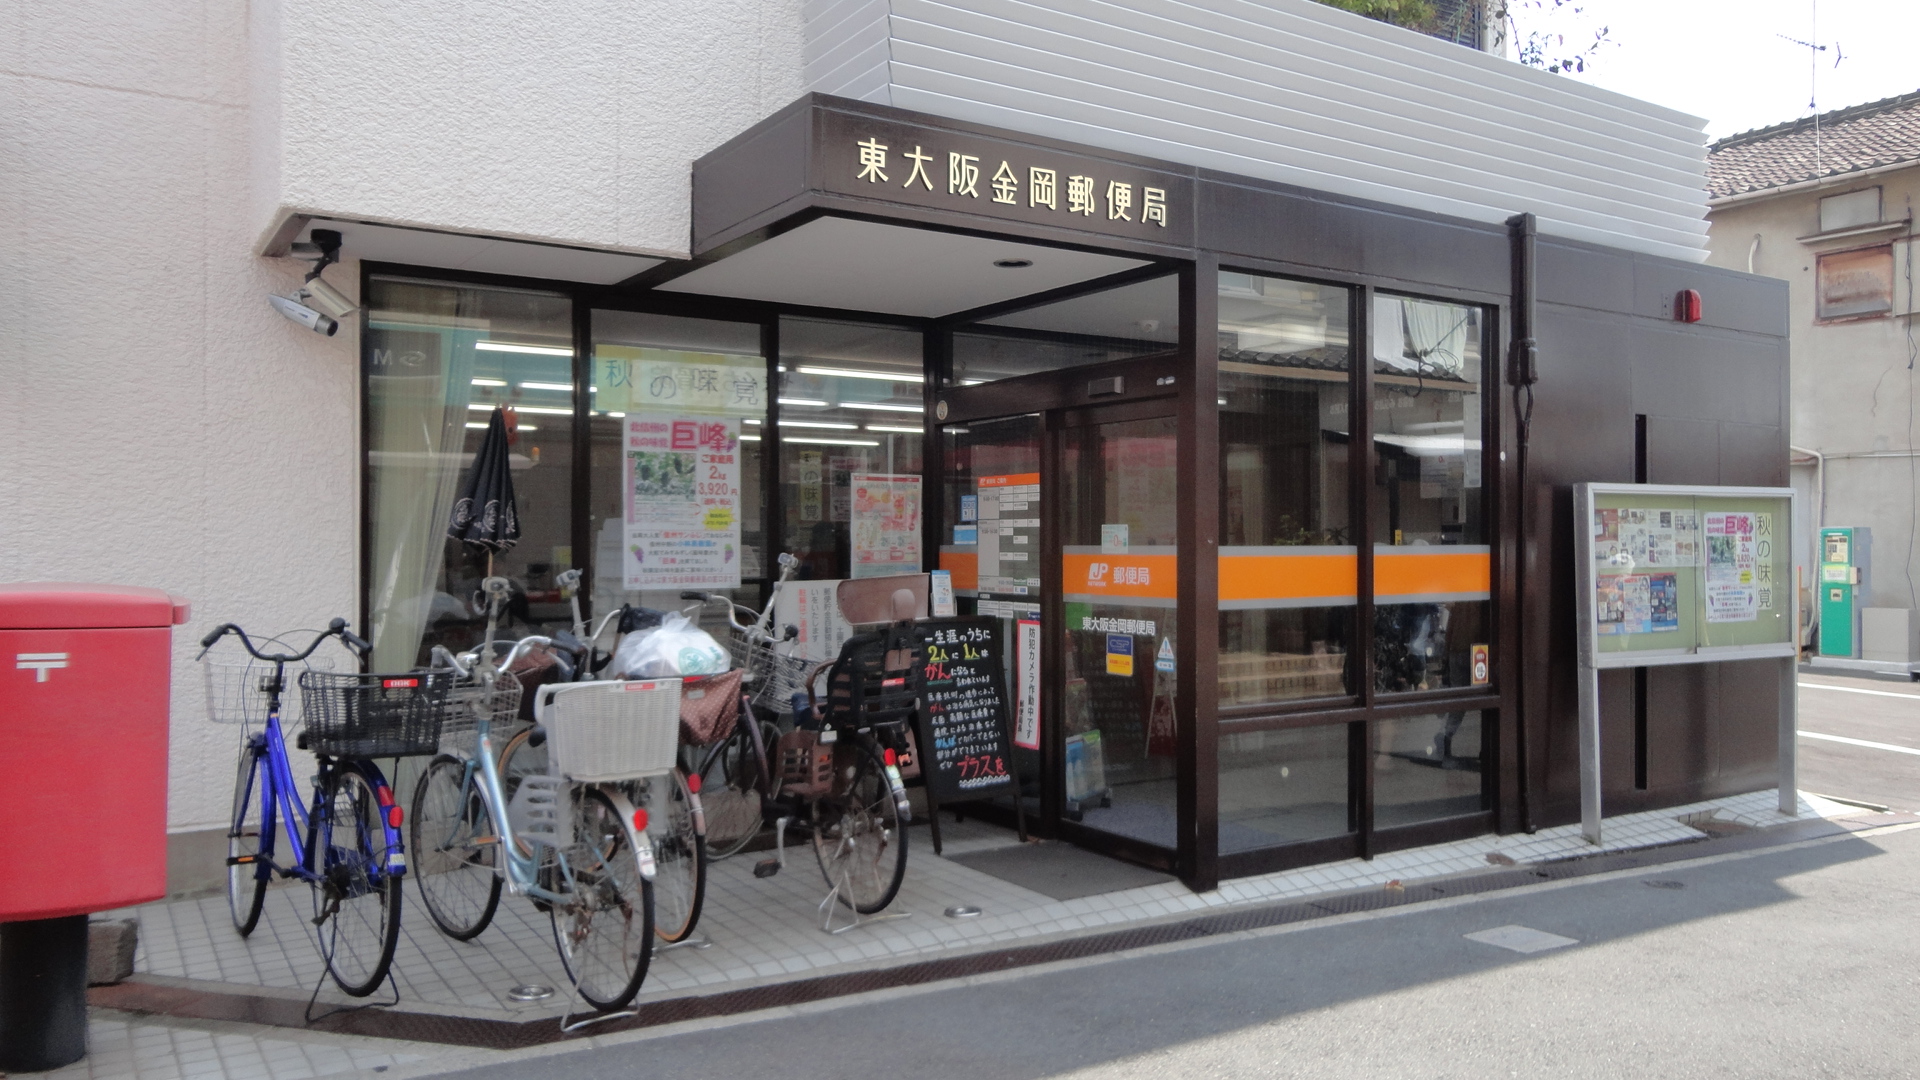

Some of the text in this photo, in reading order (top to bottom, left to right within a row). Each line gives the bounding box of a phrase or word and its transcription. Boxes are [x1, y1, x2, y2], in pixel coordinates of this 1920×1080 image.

[856, 137, 1167, 228] 東大阪金岡郵便局
[605, 359, 759, 405] 秋の味覚
[670, 420, 727, 452] 巨峰
[1724, 514, 1749, 535] 巨峰
[1756, 515, 1772, 609] 秋の味覚
[1113, 566, 1150, 586] 郵便局
[924, 627, 991, 645] 一生涯のうちに
[1081, 616, 1156, 637] 東大阪金岡郵便局
[1026, 627, 1036, 740] 防犯カメラ作動中です
[957, 754, 1008, 777] プラスを
